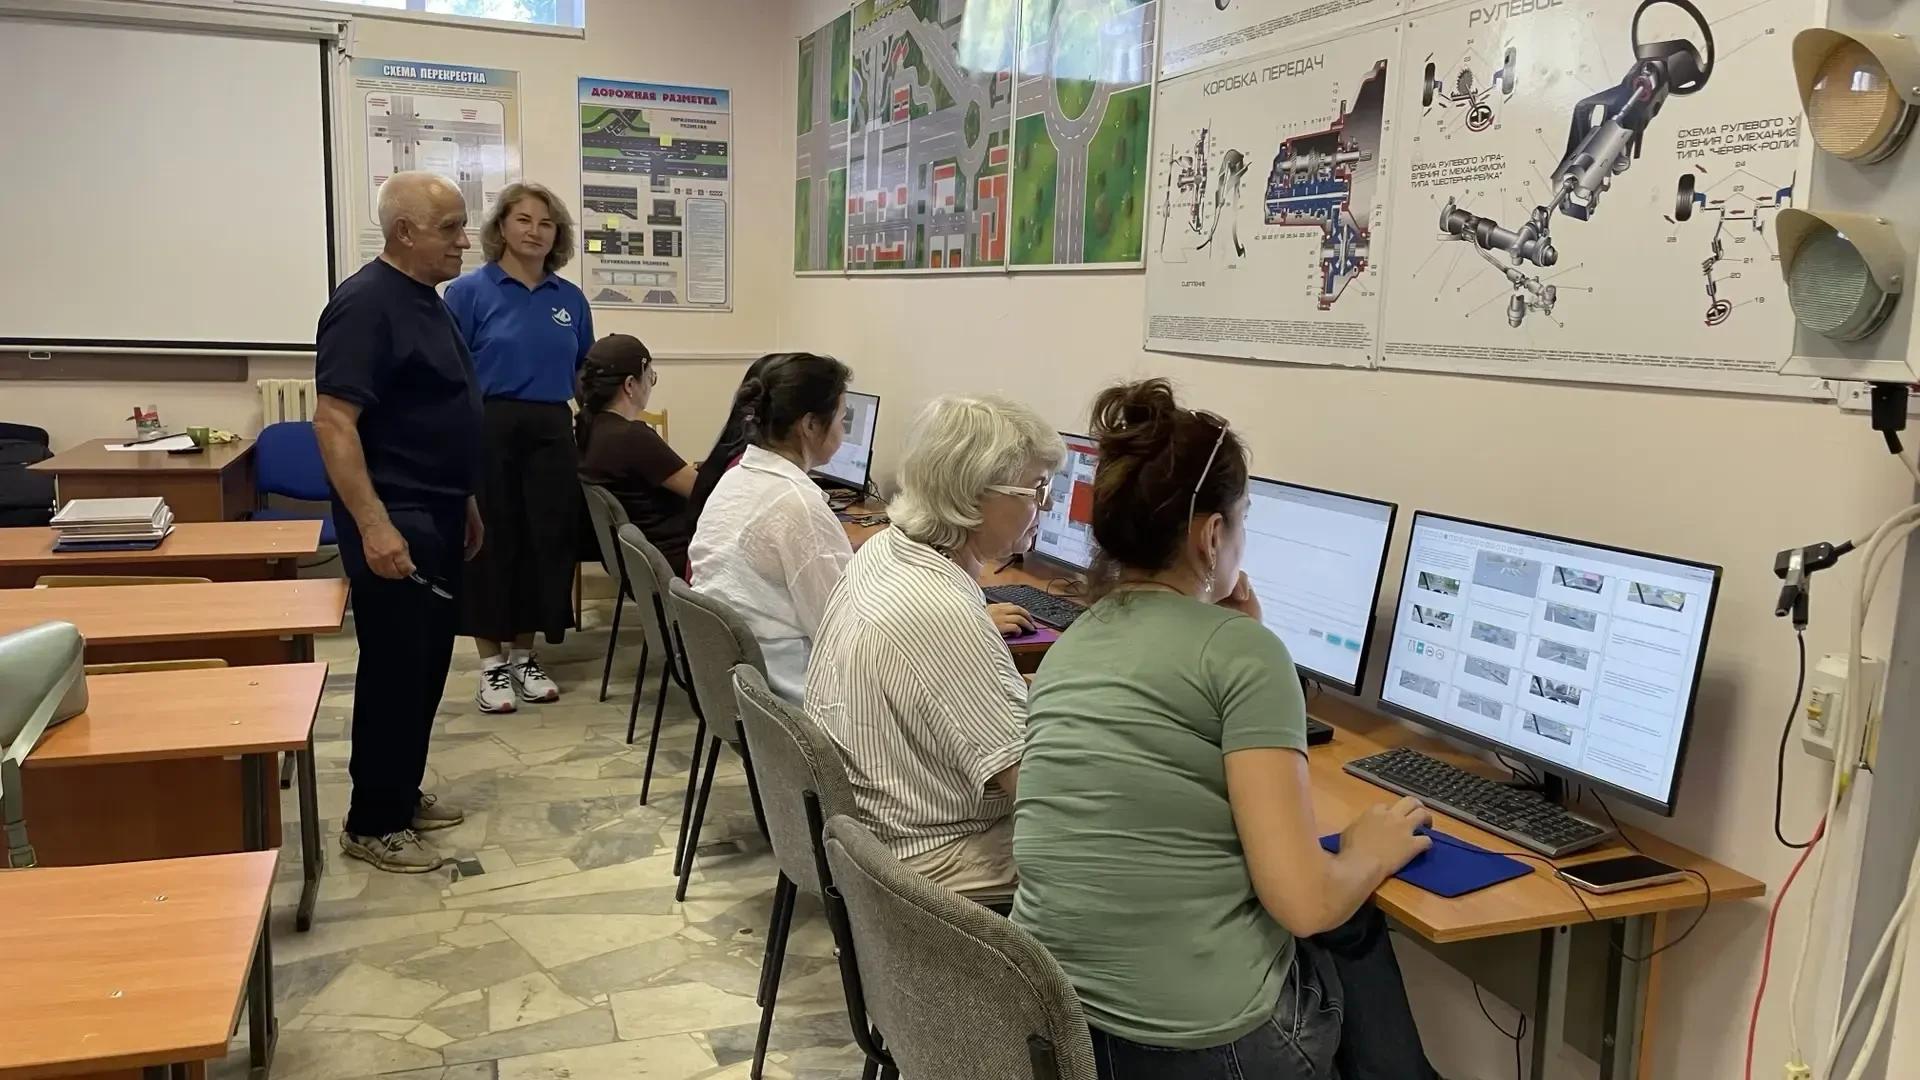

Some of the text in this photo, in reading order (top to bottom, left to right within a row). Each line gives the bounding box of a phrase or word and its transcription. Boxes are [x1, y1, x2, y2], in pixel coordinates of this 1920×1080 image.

[383, 65, 487, 84] СХЕМА ПЕРЕКРЕСТКА
[1203, 54, 1324, 97] КОРОБКА ПЕРЕДАЧ
[591, 87, 718, 105] ДОРОЖНАЯ РАЗМЕТКА
[1678, 126, 1717, 138] СХЕМА
[1720, 117, 1783, 133] РУЛЕВОГО
[1677, 136, 1721, 149] ВЛЕНИЯ
[1725, 134, 1734, 144] С
[1411, 153, 1504, 172] СХЕМА РУЛЕВОГО УПРА-
[1676, 149, 1705, 160] ТИПА
[1411, 170, 1439, 180] ВЛЕНИЯ
[1449, 162, 1506, 175] МЕХАНИЗМОМ
[1411, 180, 1429, 189] ТИПА
[1735, 236, 1746, 244] 22
